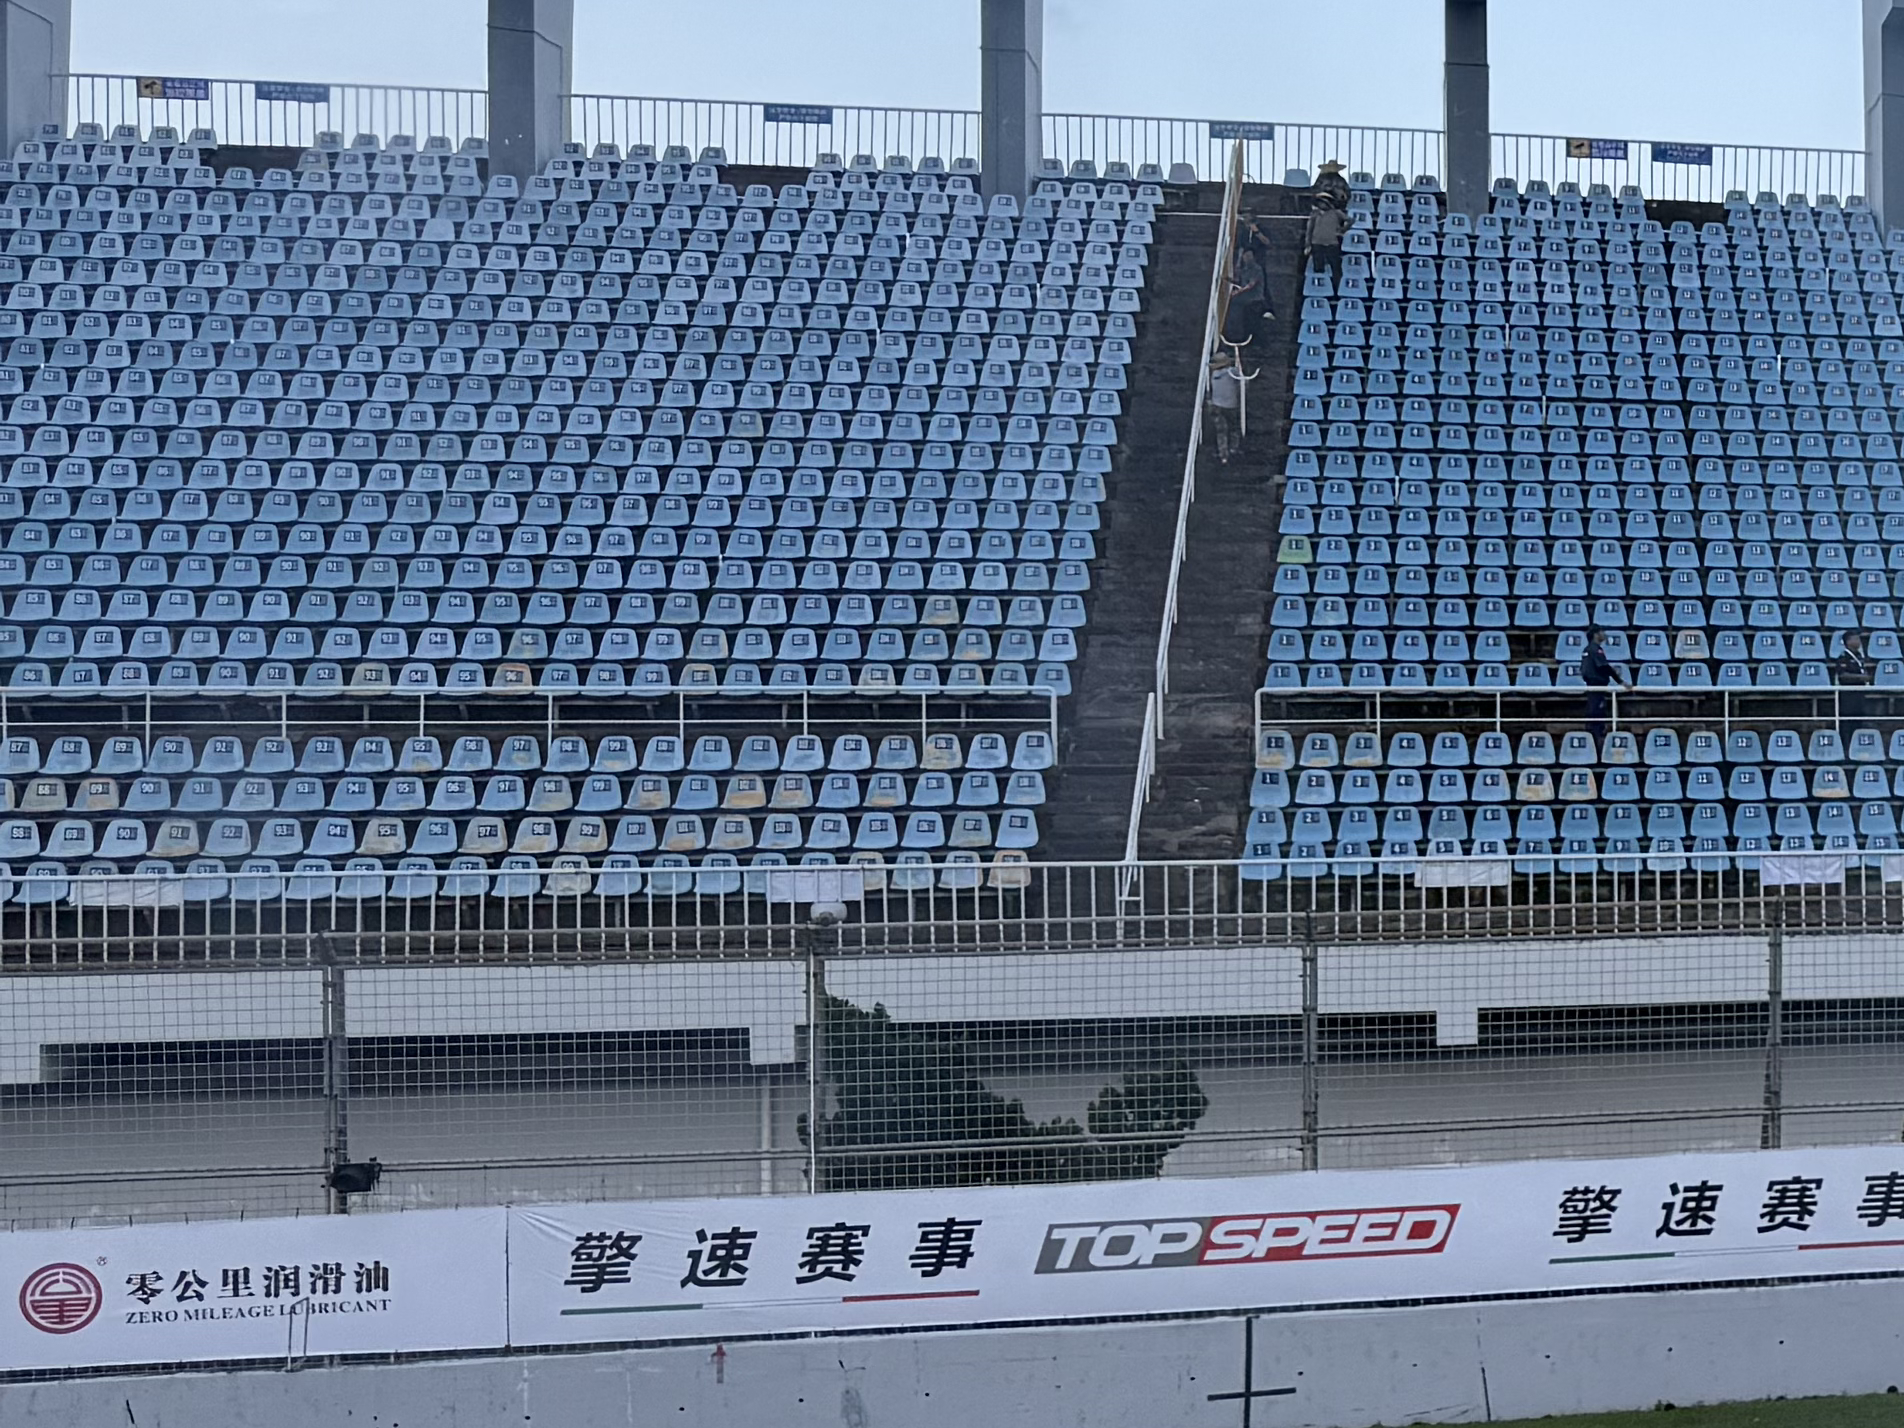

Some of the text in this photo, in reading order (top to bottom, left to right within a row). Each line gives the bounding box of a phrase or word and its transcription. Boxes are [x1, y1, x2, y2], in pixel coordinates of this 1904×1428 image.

[563, 1217, 984, 1294] 擎速赛事
[125, 1260, 391, 1305] 零公里润滑油
[125, 1298, 393, 1325] ZERO MILEAGE LUBRICANT
